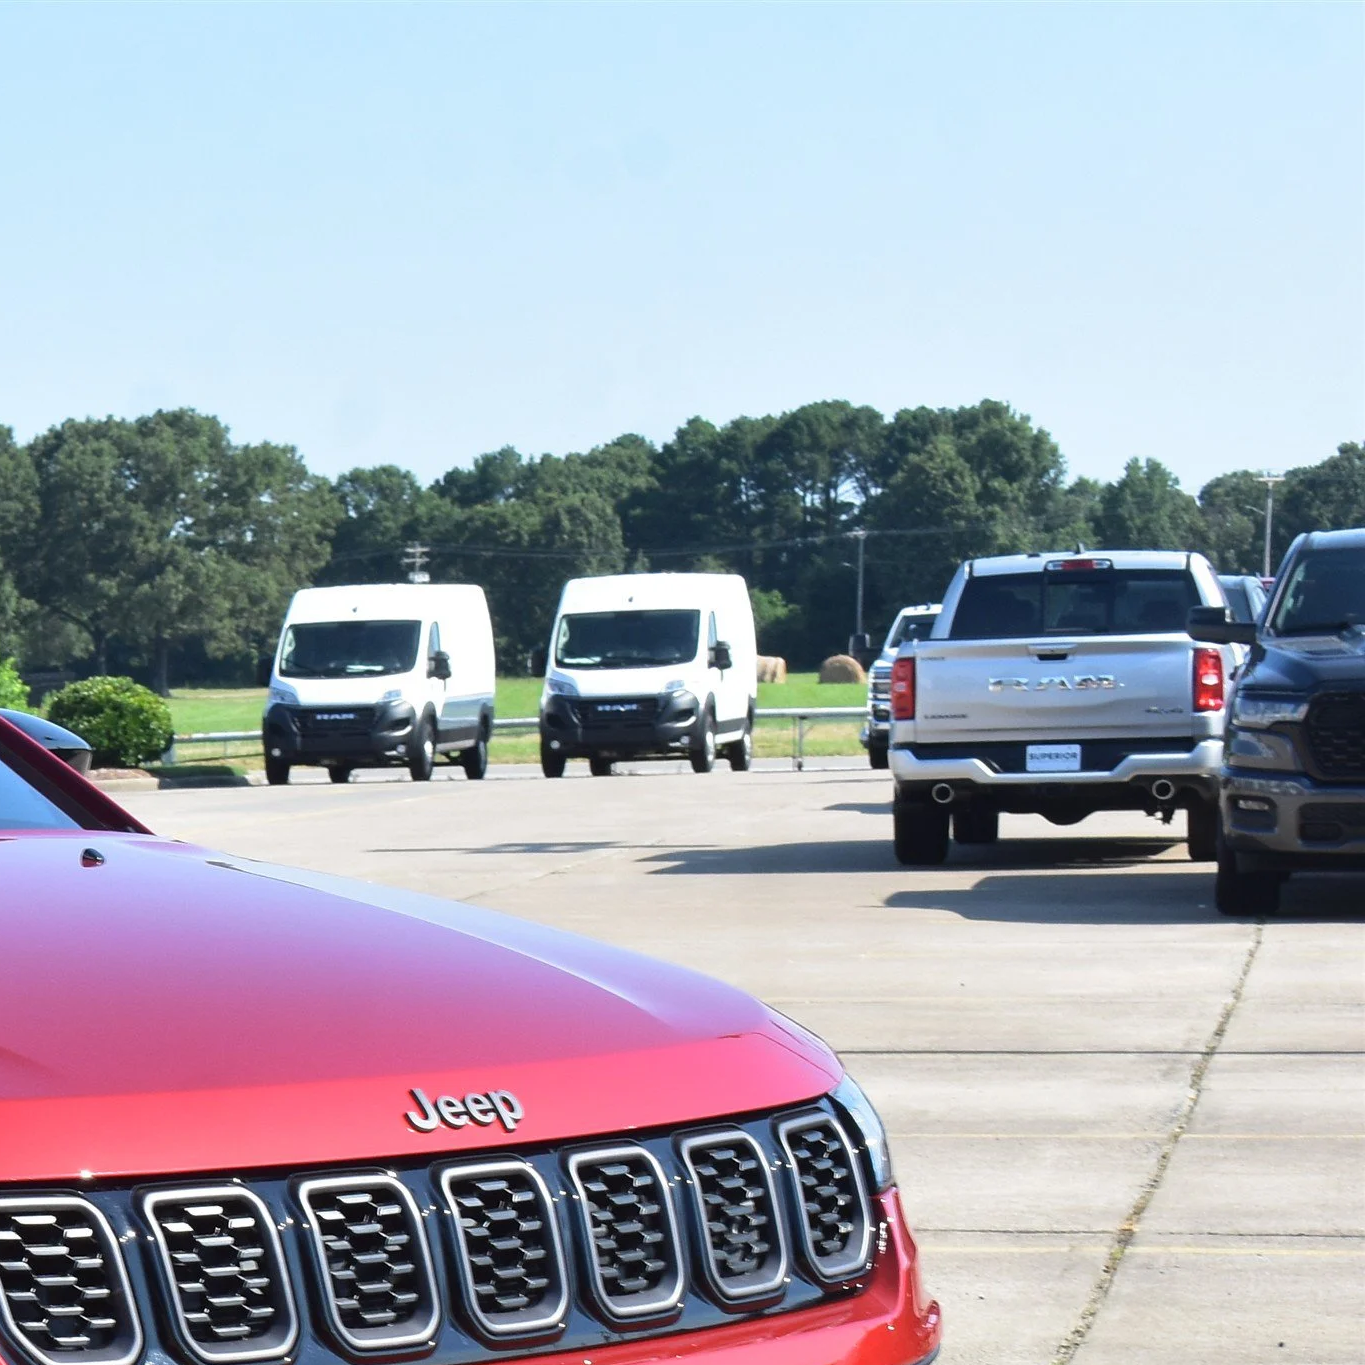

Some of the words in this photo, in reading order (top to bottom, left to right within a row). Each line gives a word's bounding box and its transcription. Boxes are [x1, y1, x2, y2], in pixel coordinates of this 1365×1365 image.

[988, 674, 1124, 692] RAM
[1028, 752, 1078, 760] SUPERIOR
[404, 1087, 525, 1133] Jeep
